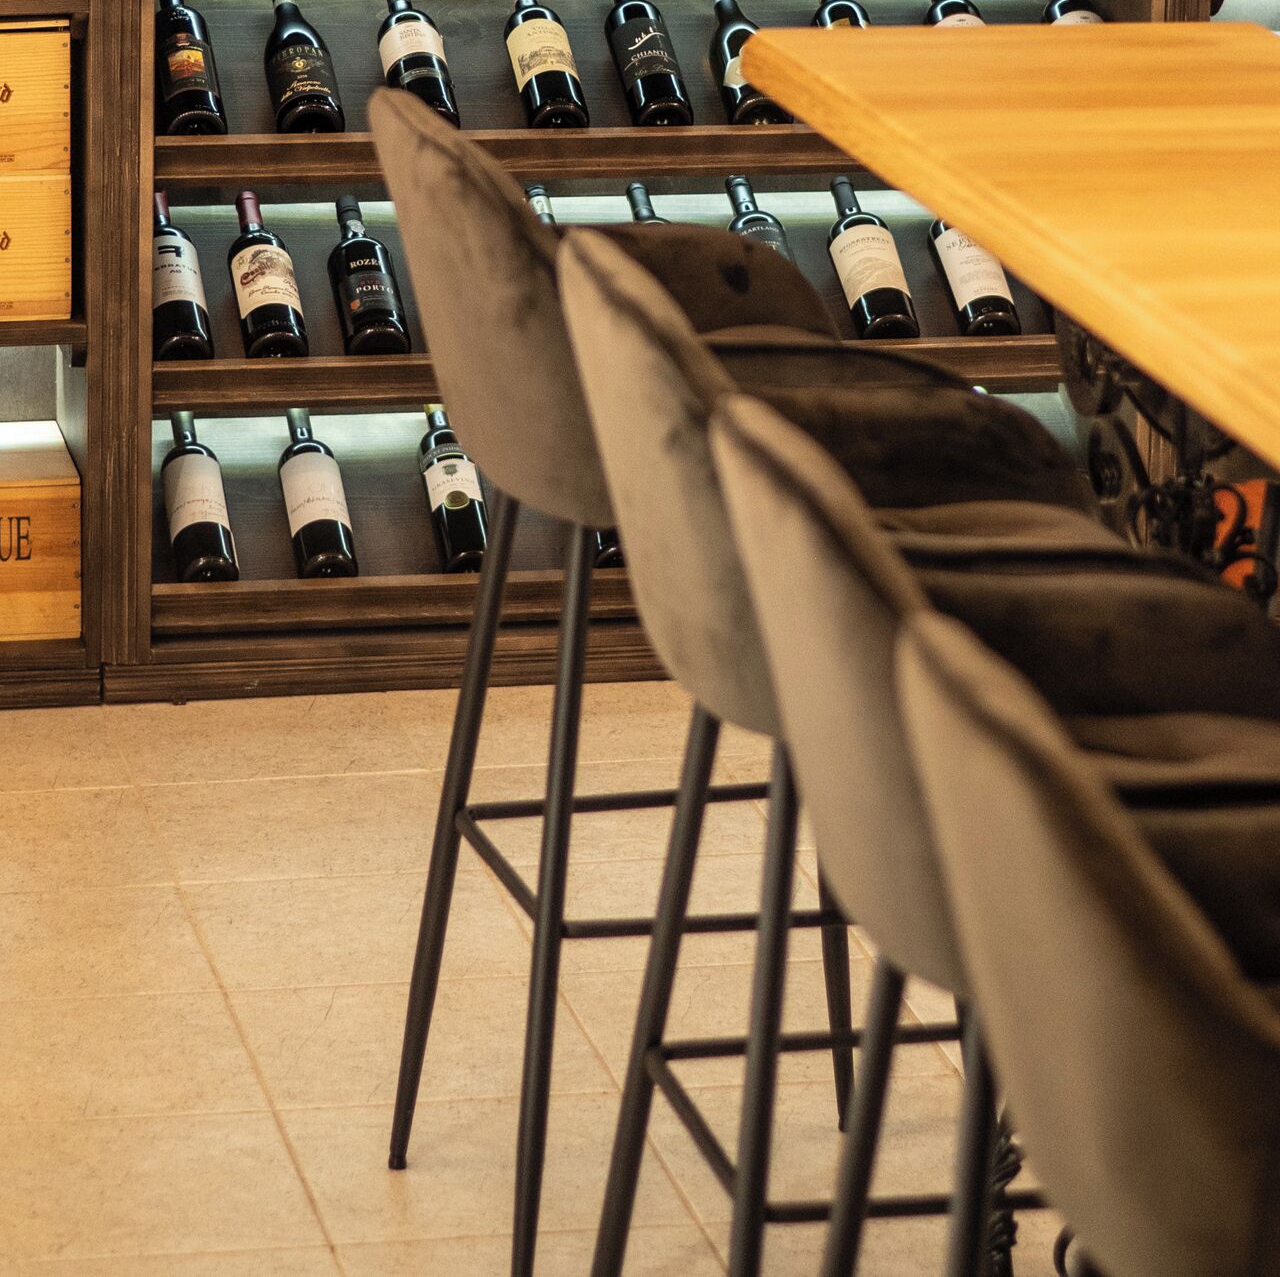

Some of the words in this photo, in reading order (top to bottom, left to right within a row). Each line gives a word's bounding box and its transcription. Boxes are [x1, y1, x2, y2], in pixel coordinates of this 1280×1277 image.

[630, 49, 669, 62] CHIANTI
[154, 263, 198, 275] ERRATUS
[356, 284, 394, 294] PORTO
